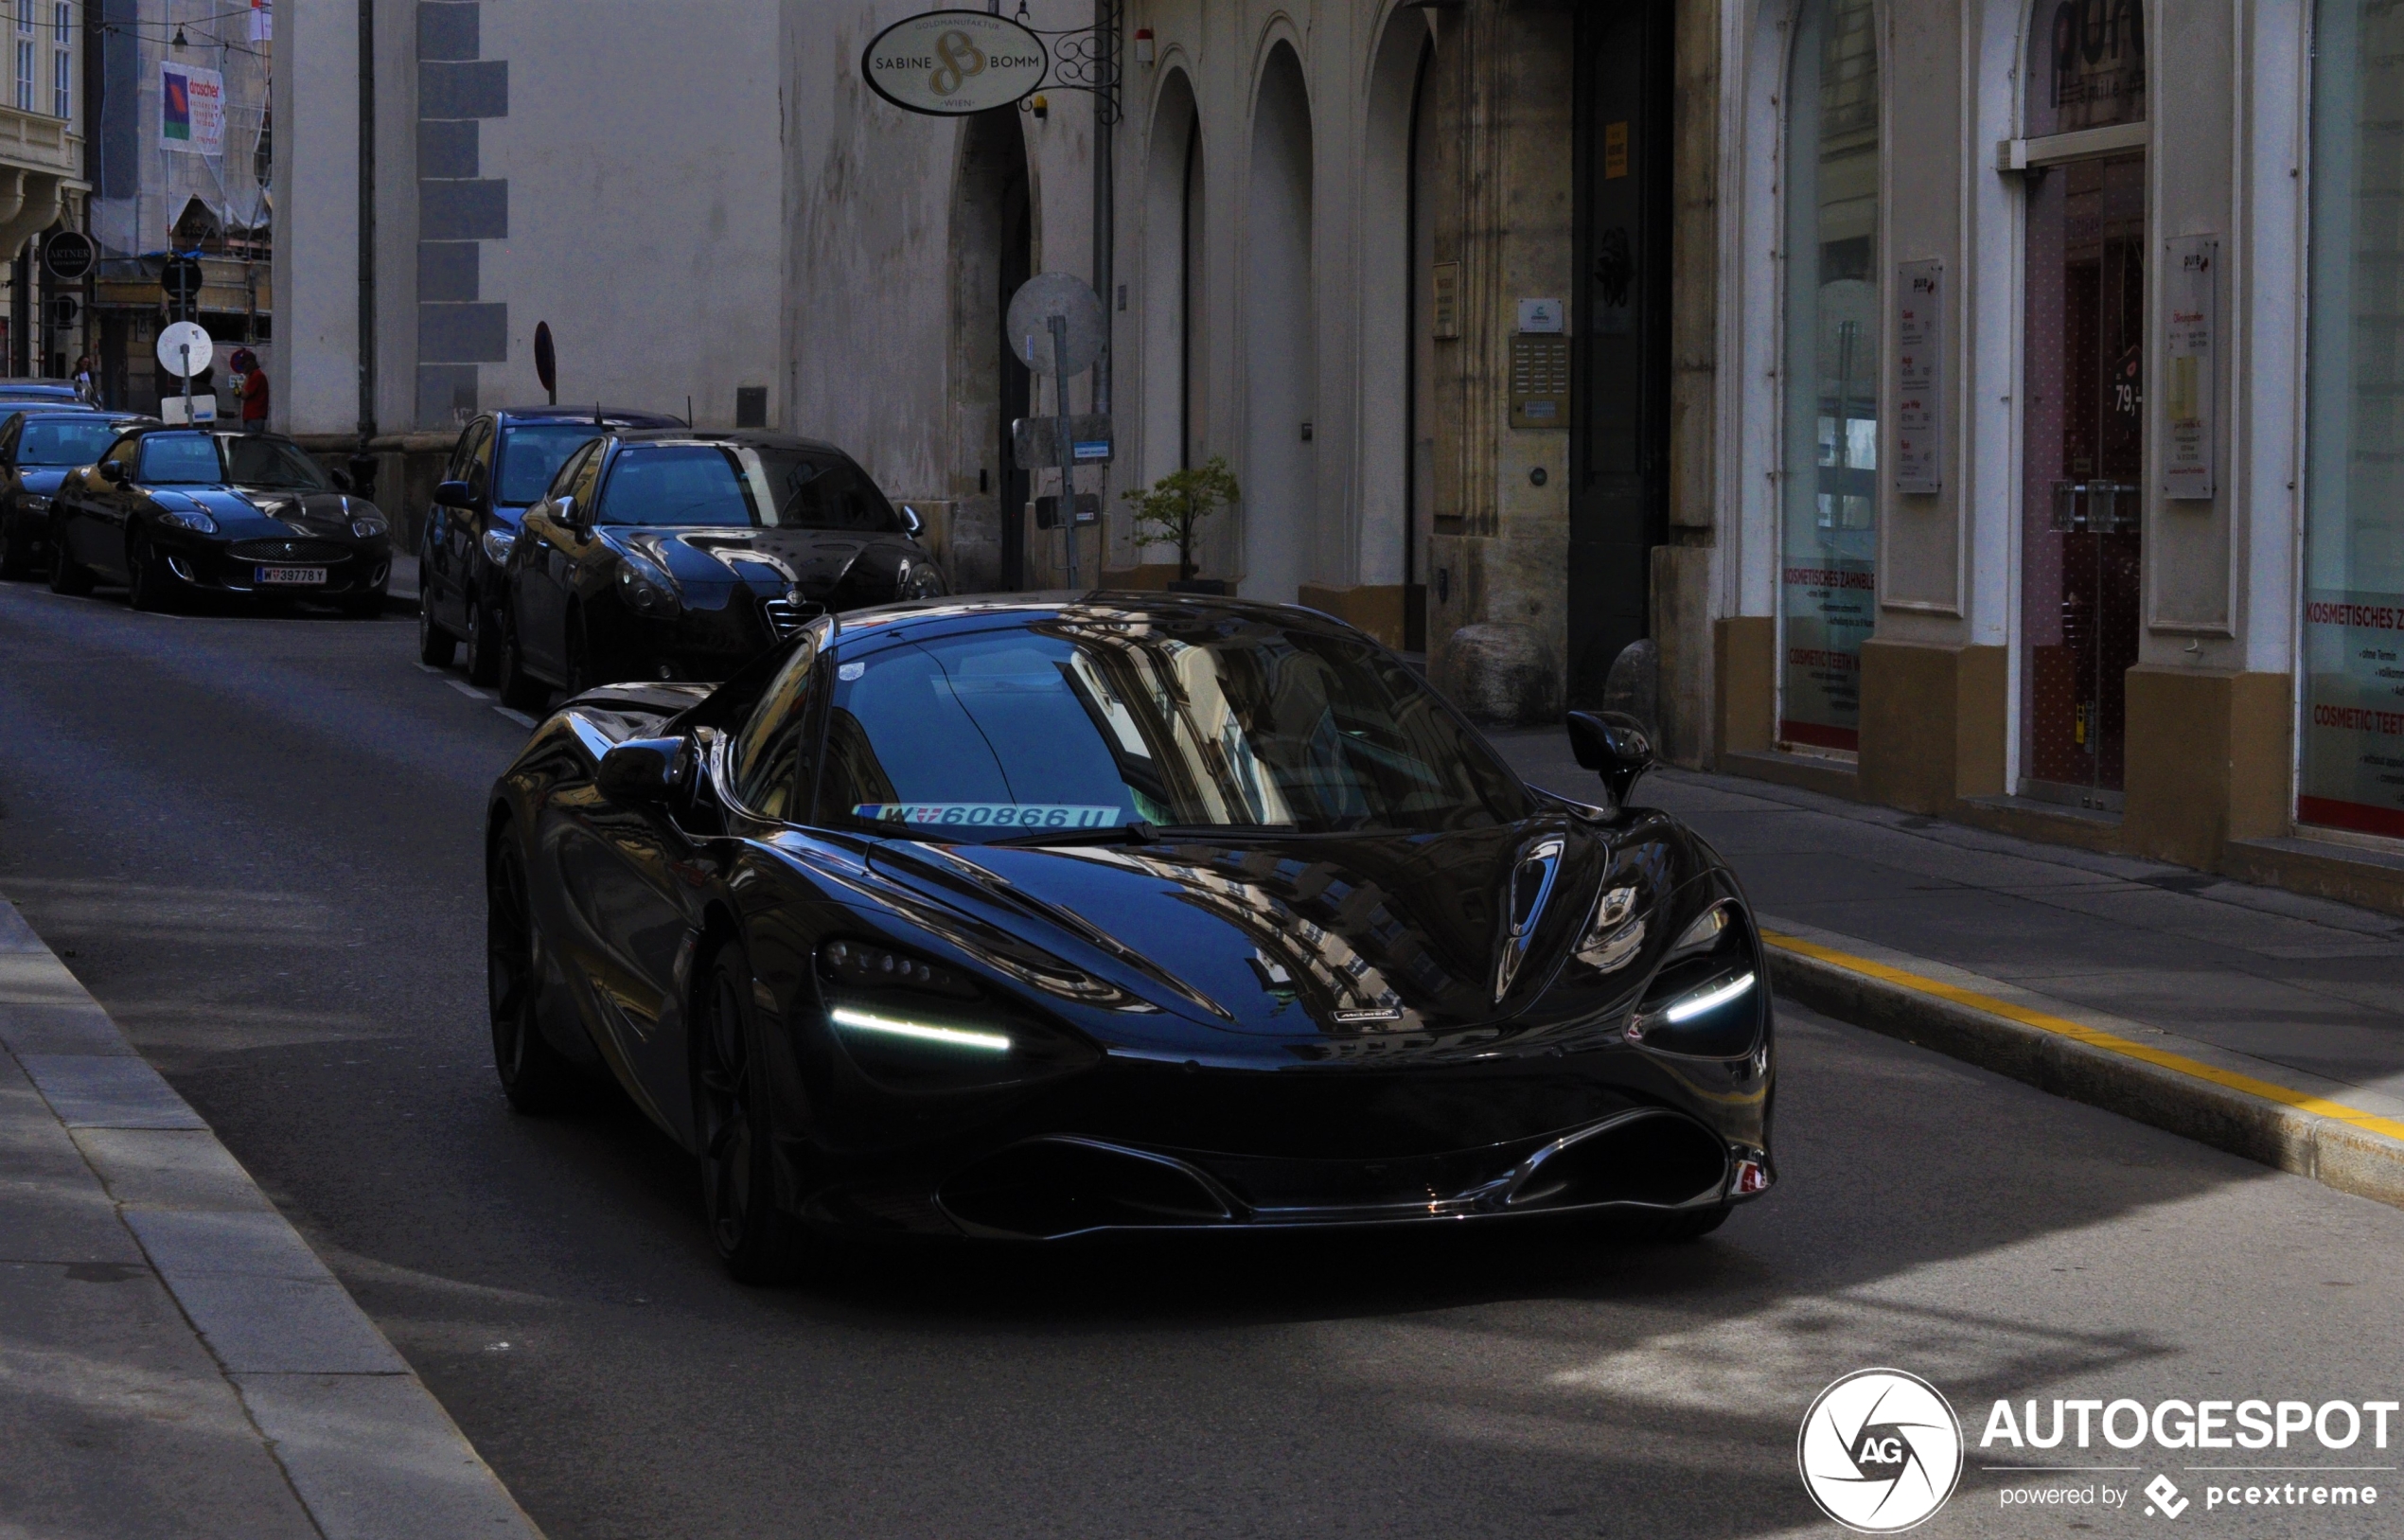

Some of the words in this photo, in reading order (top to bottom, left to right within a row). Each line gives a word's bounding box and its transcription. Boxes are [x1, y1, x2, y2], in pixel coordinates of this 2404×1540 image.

[915, 19, 1000, 31] GOLDMANUFAKTUR
[875, 57, 932, 69] SABINE
[990, 56, 1040, 68] BOMM
[50, 248, 90, 258] ARTNER
[265, 570, 272, 580] W
[280, 570, 314, 581] 39778
[317, 570, 324, 581] Y
[1783, 568, 1838, 587] KOSMETISCHES
[2306, 602, 2394, 629] KOSMETISCHES
[1789, 648, 1826, 666] COSMETIC
[1828, 651, 1851, 671] TEETH
[2314, 703, 2372, 731] COSMETIC
[2375, 710, 2404, 735] TEET
[885, 806, 914, 823] W
[941, 806, 1069, 826] 60866
[1078, 810, 1104, 827] U
